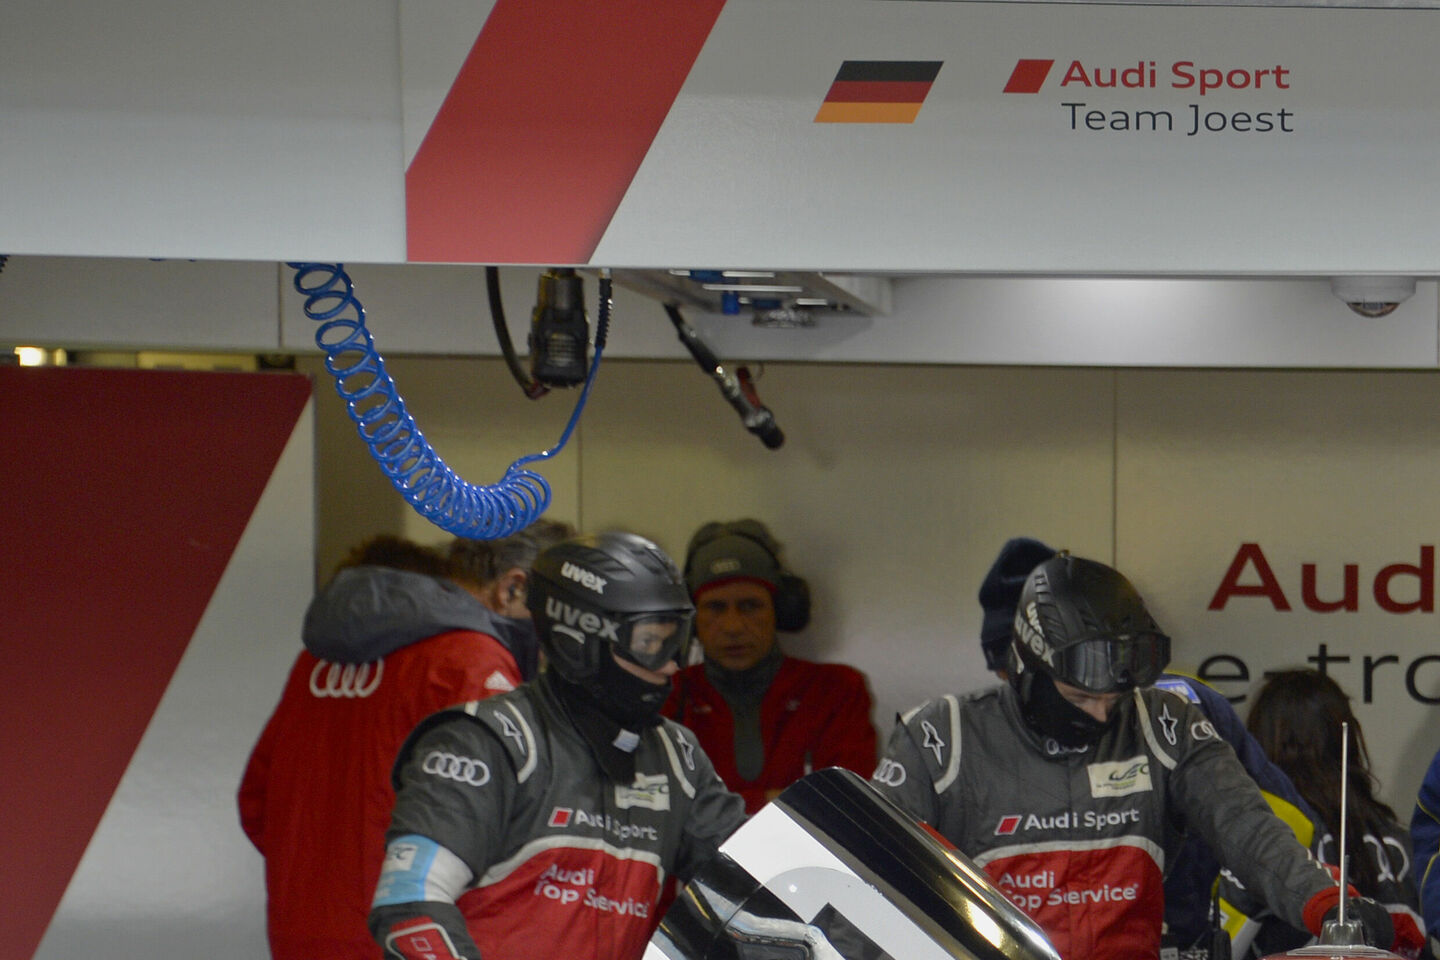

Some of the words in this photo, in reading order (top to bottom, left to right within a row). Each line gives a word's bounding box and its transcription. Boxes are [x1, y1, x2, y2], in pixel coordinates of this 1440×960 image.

[1060, 60, 1156, 89] Audi
[1171, 60, 1290, 96] Sport
[1061, 103, 1173, 132] Team
[1187, 103, 1294, 136] Joest
[560, 561, 607, 595] uvex
[545, 597, 622, 643] uvex
[1024, 811, 1079, 831] Audi
[1084, 808, 1140, 832] Sport
[540, 863, 595, 886] Audi
[999, 870, 1055, 889] Audi
[1004, 889, 1043, 912] op
